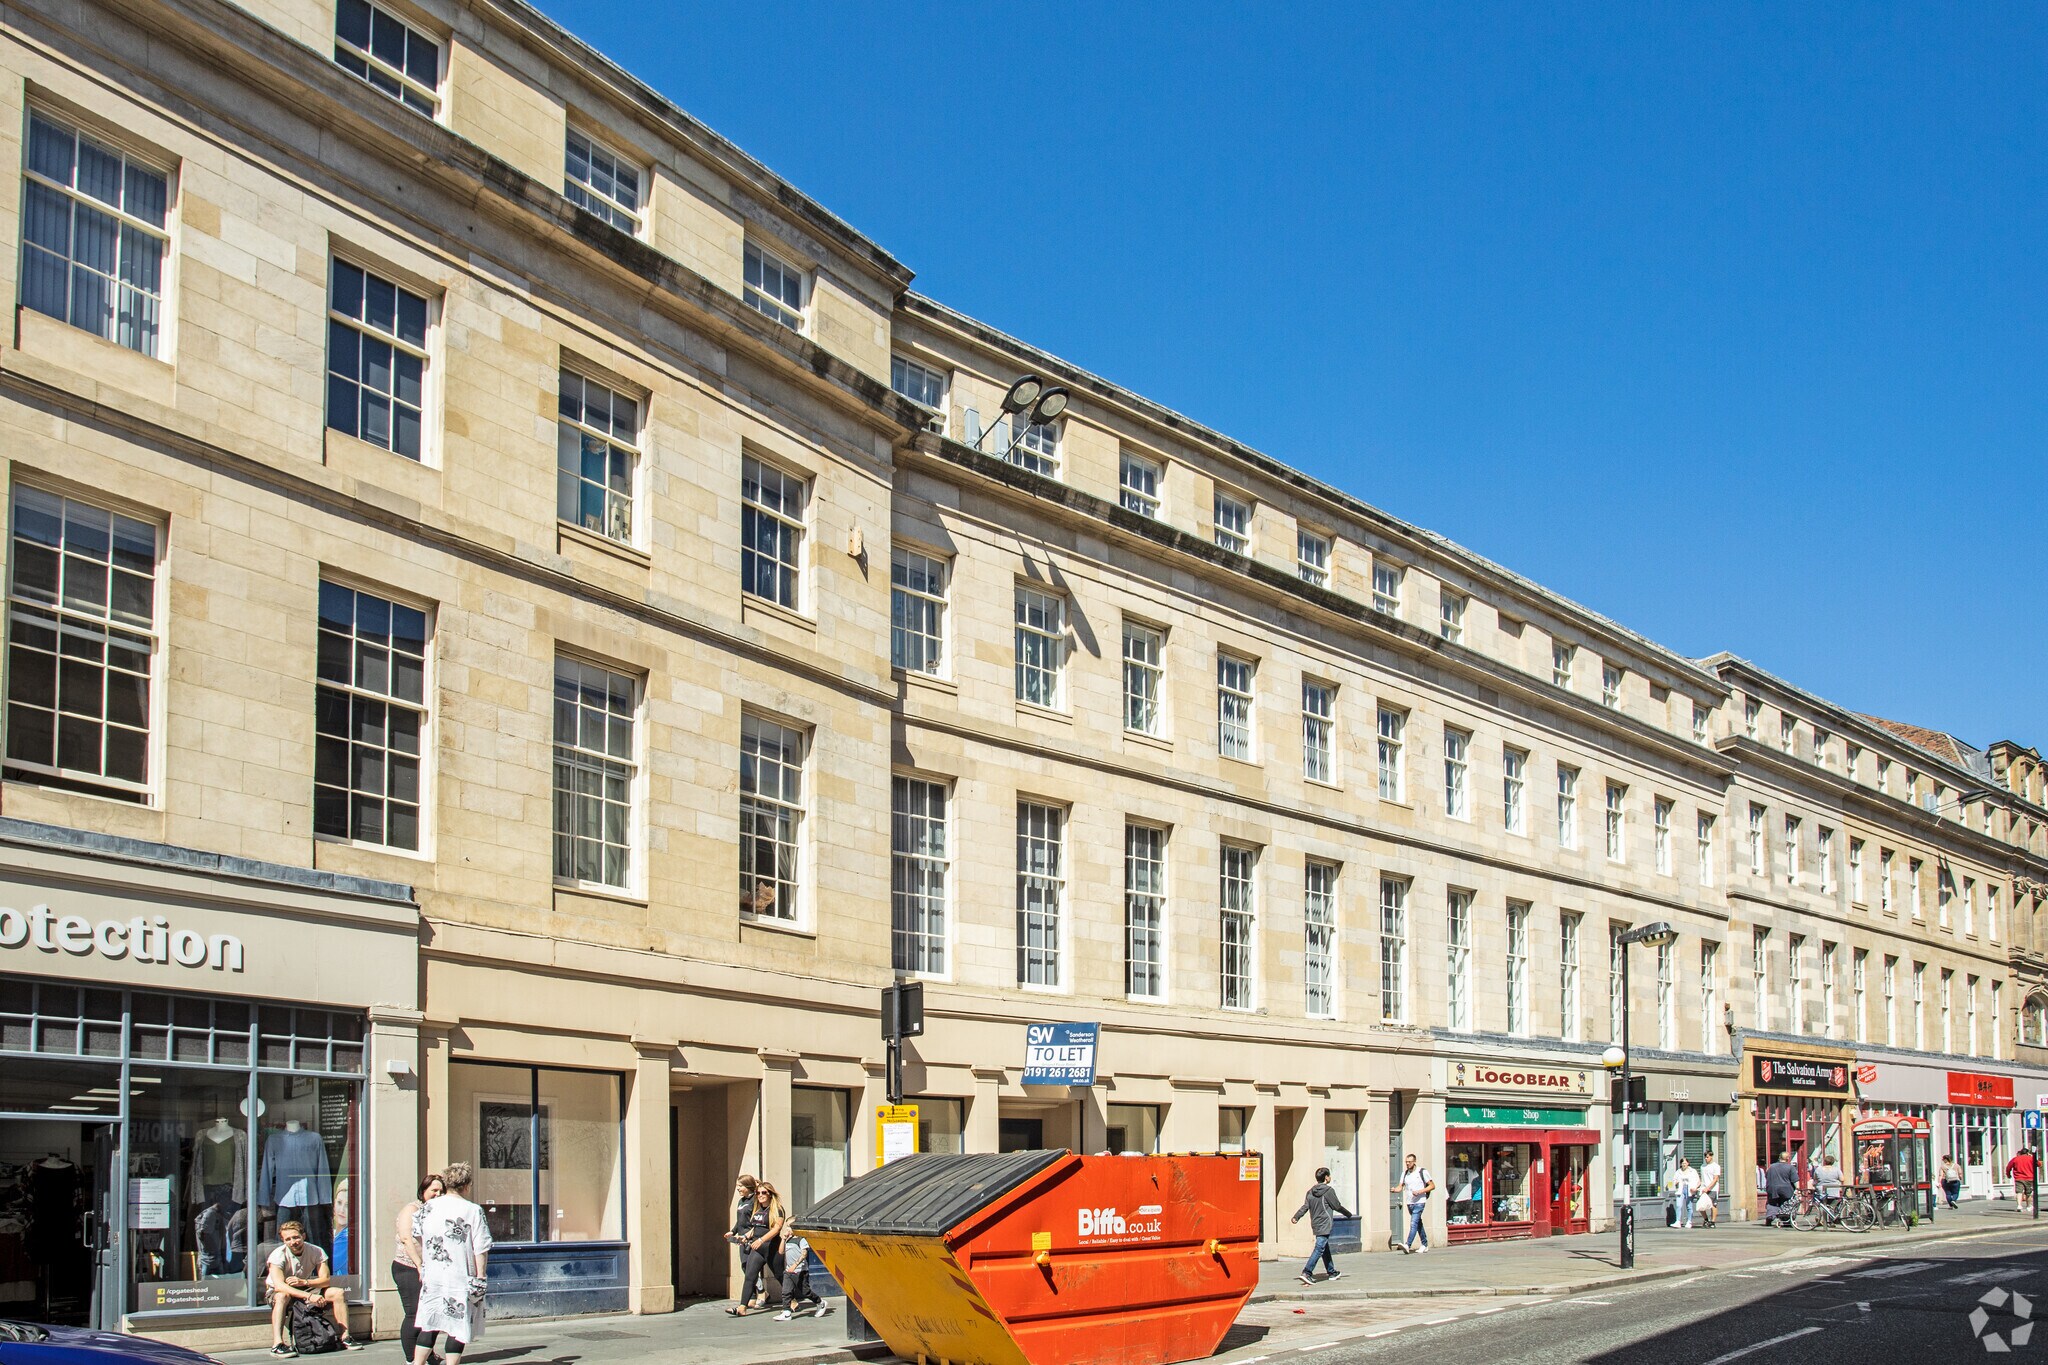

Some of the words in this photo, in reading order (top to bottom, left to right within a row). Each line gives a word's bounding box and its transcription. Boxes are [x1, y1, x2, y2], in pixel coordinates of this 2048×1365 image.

[0, 904, 244, 972] otection
[1028, 1026, 1054, 1044] SW
[1034, 1048, 1054, 1061] TO
[1059, 1047, 1086, 1061] LET
[1024, 1067, 1046, 1077] 0191
[1049, 1068, 1066, 1077] 261
[1068, 1068, 1090, 1077] 2681
[1773, 1061, 1786, 1074] The
[1787, 1062, 1815, 1077] Salvation
[1816, 1065, 1832, 1080] Army
[1475, 1070, 1570, 1087] LOGOBEAR
[1482, 1108, 1495, 1118] The
[1523, 1110, 1539, 1121] Shop
[166, 1287, 208, 1296] /cpgateshead
[166, 1295, 220, 1304] @gateshead_cats
